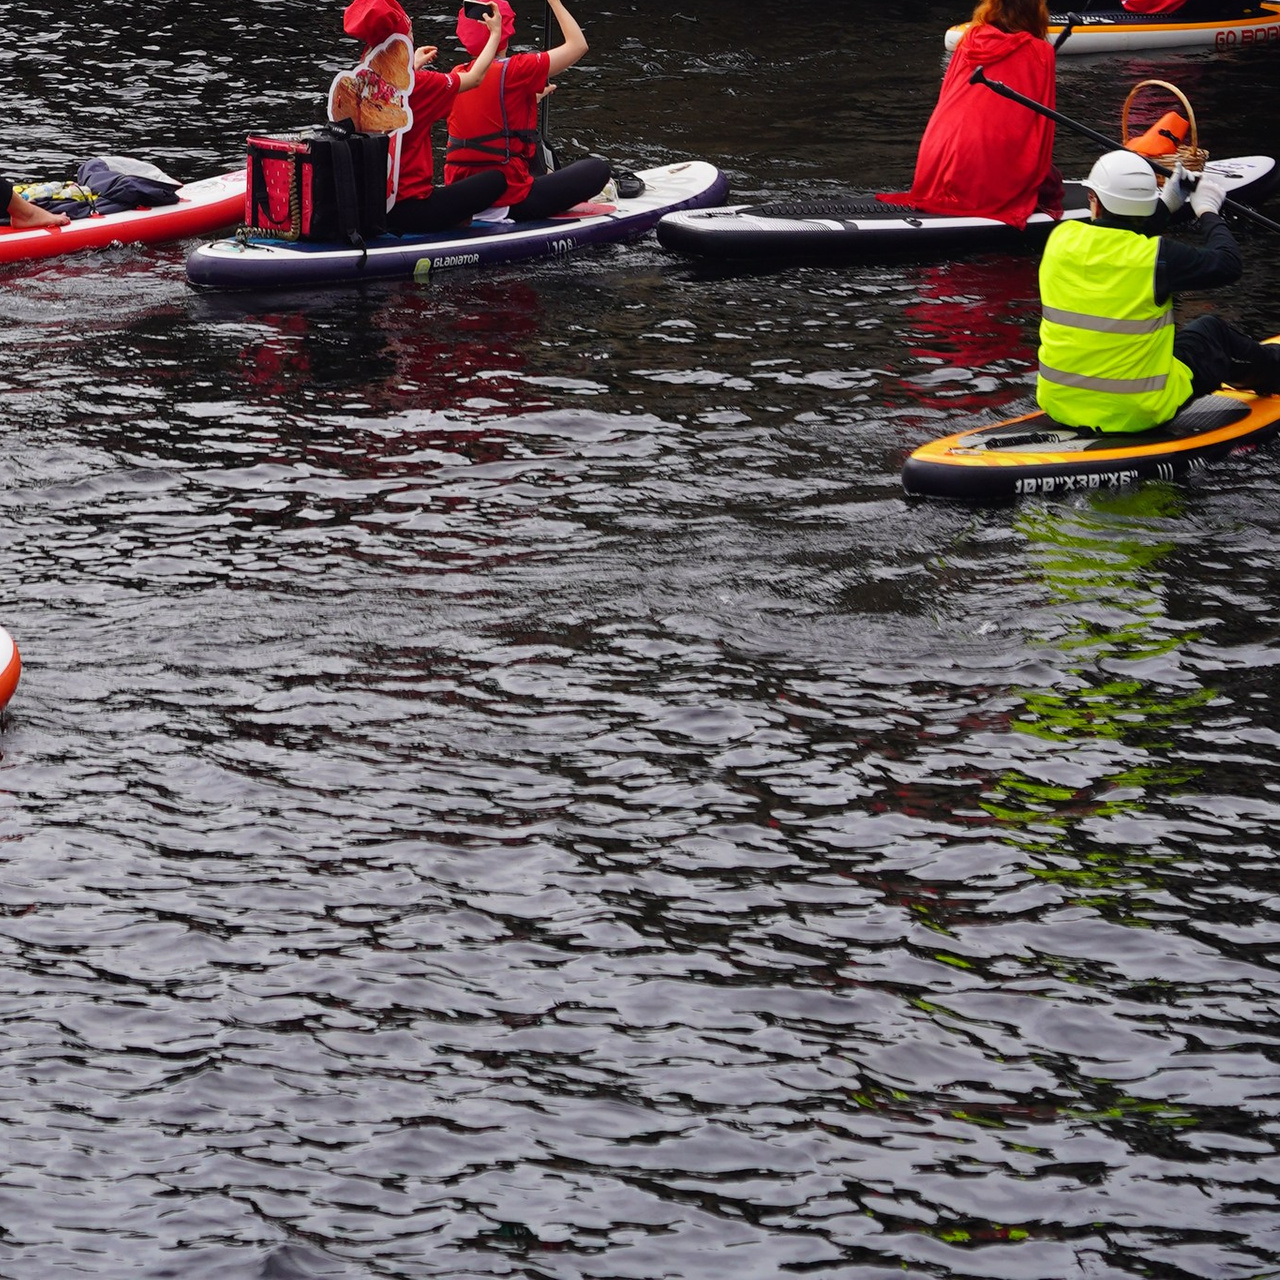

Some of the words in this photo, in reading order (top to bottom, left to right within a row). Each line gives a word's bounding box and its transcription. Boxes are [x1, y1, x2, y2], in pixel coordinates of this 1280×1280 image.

[1215, 30, 1237, 46] GO
[1241, 25, 1280, 45] BOA
[433, 253, 480, 268] GLADIATOR
